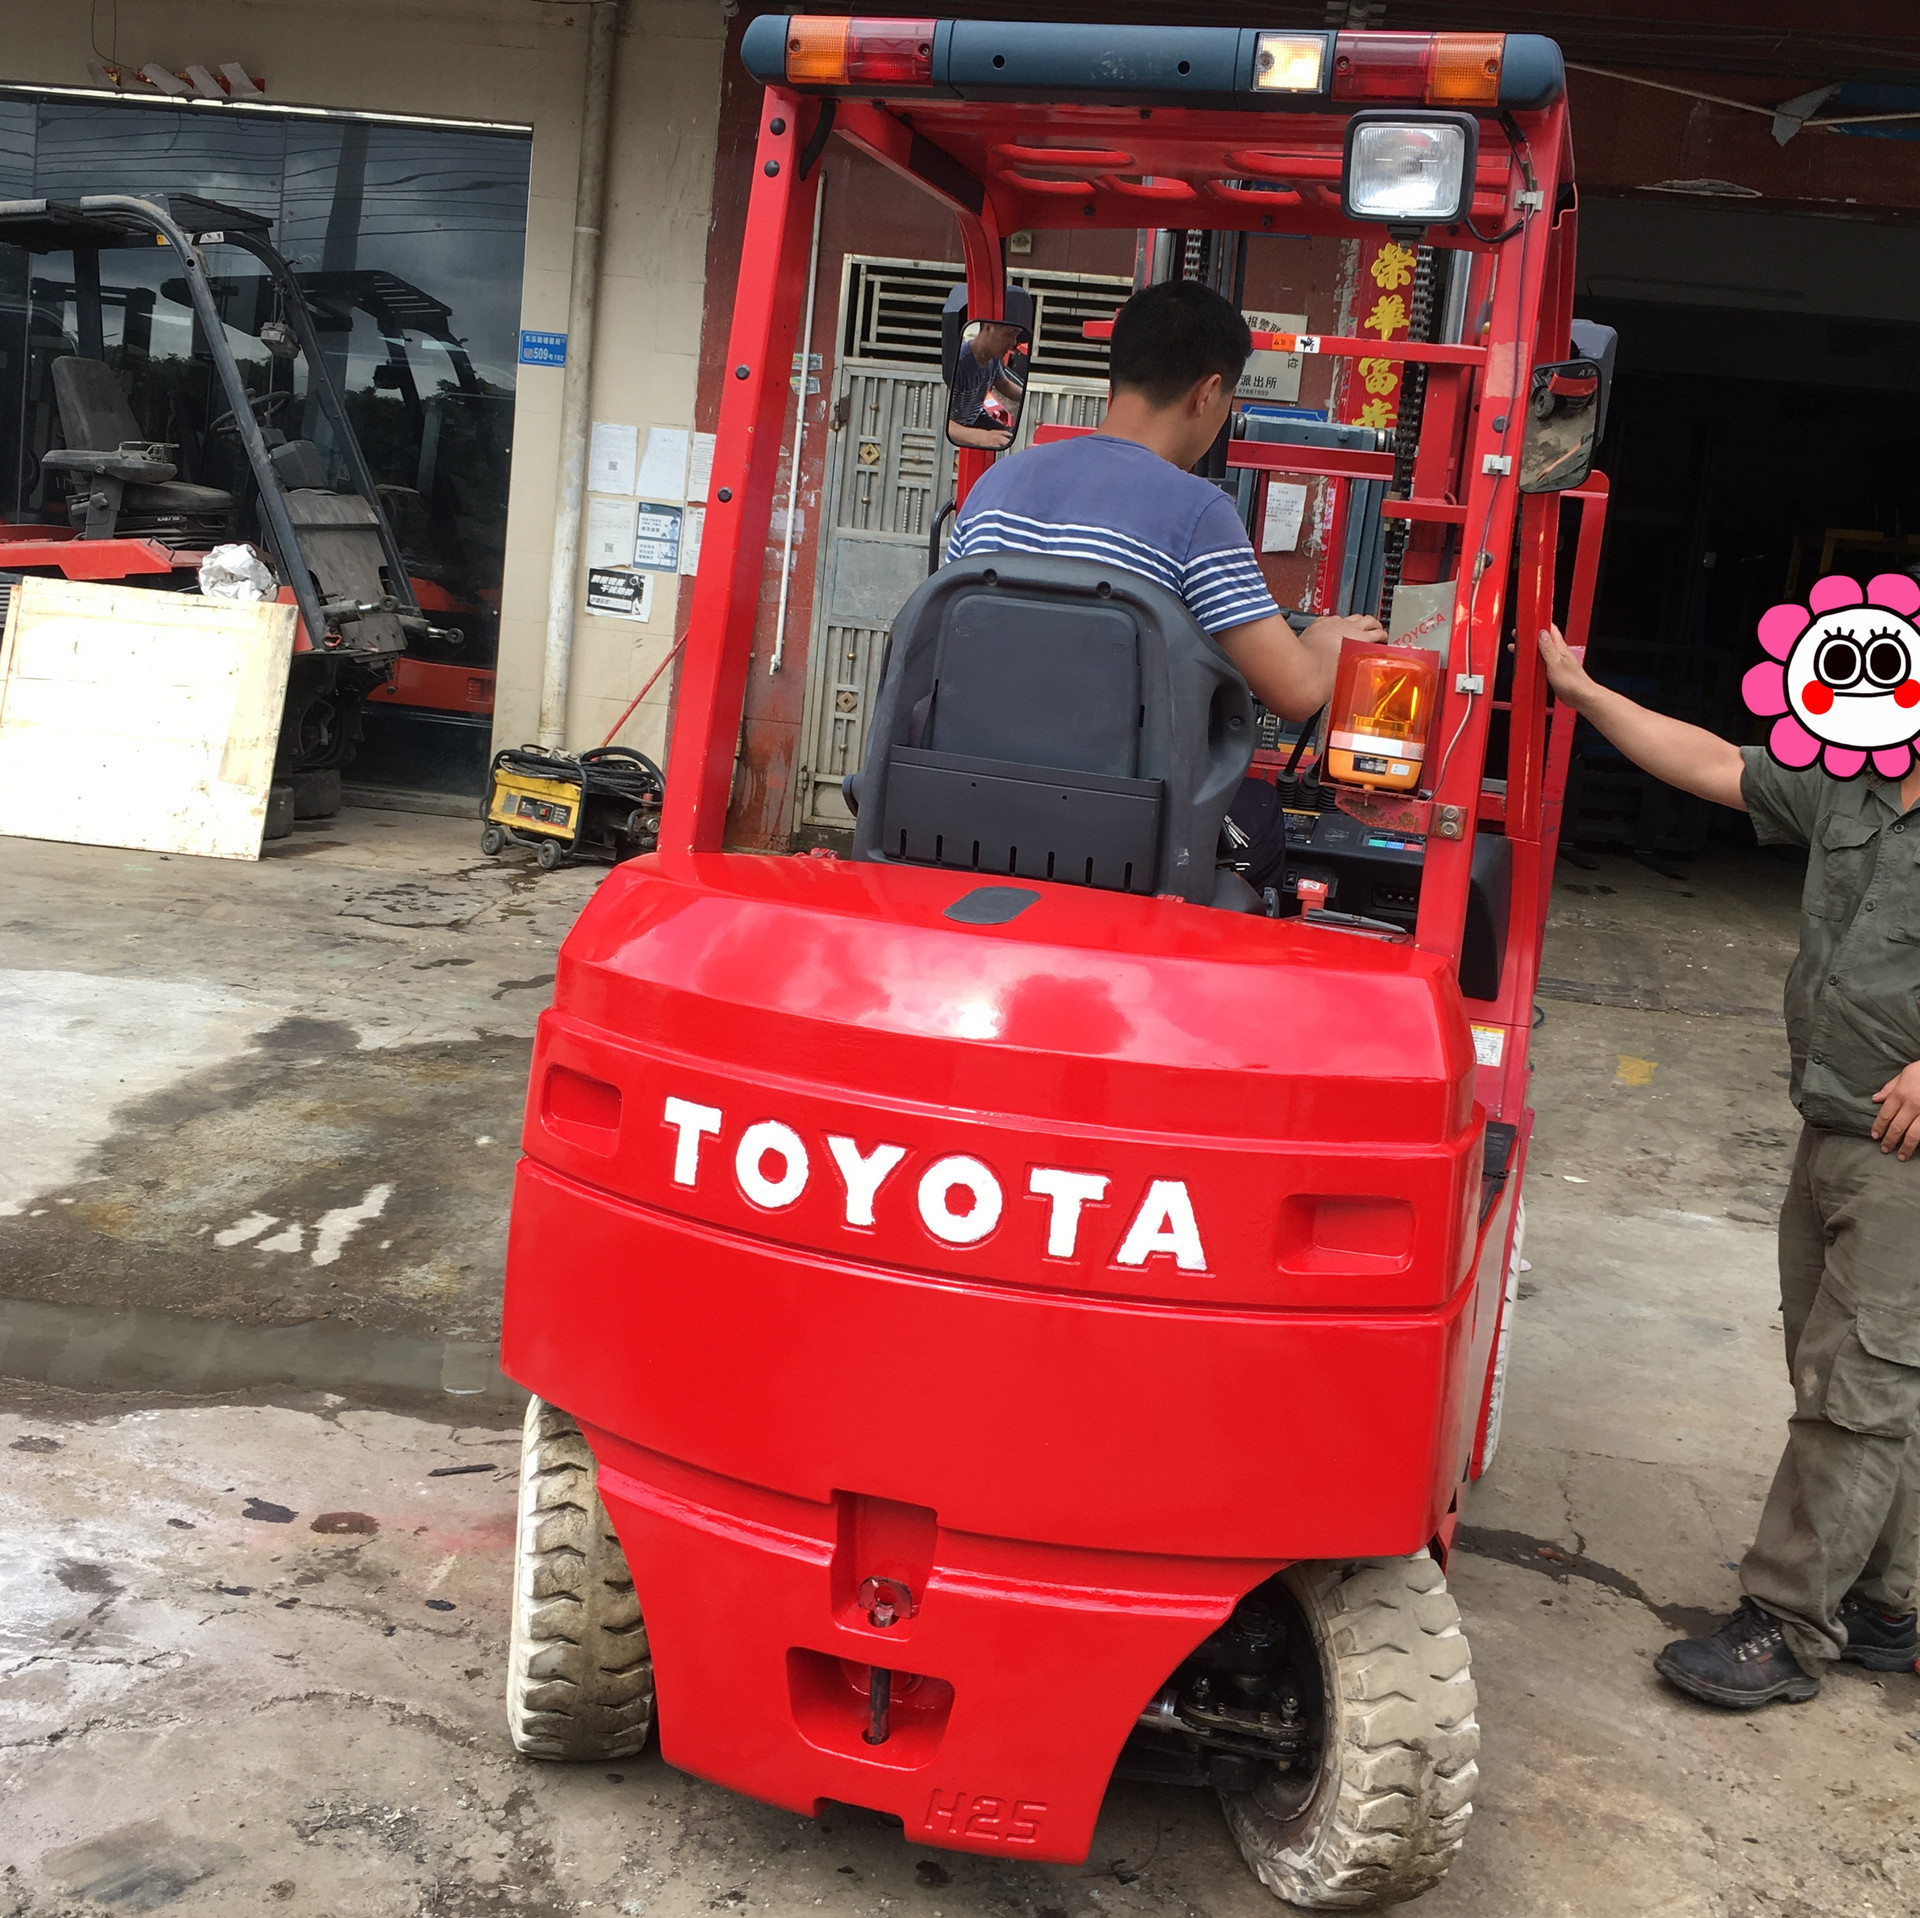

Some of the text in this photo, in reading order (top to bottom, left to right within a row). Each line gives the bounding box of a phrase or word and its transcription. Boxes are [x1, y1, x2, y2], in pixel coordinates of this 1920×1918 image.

[1240, 374, 1277, 389] 派出所
[1393, 612, 1447, 647] TOYOTA
[661, 1096, 1213, 1275] TOYOTA
[923, 1787, 1049, 1845] H25
